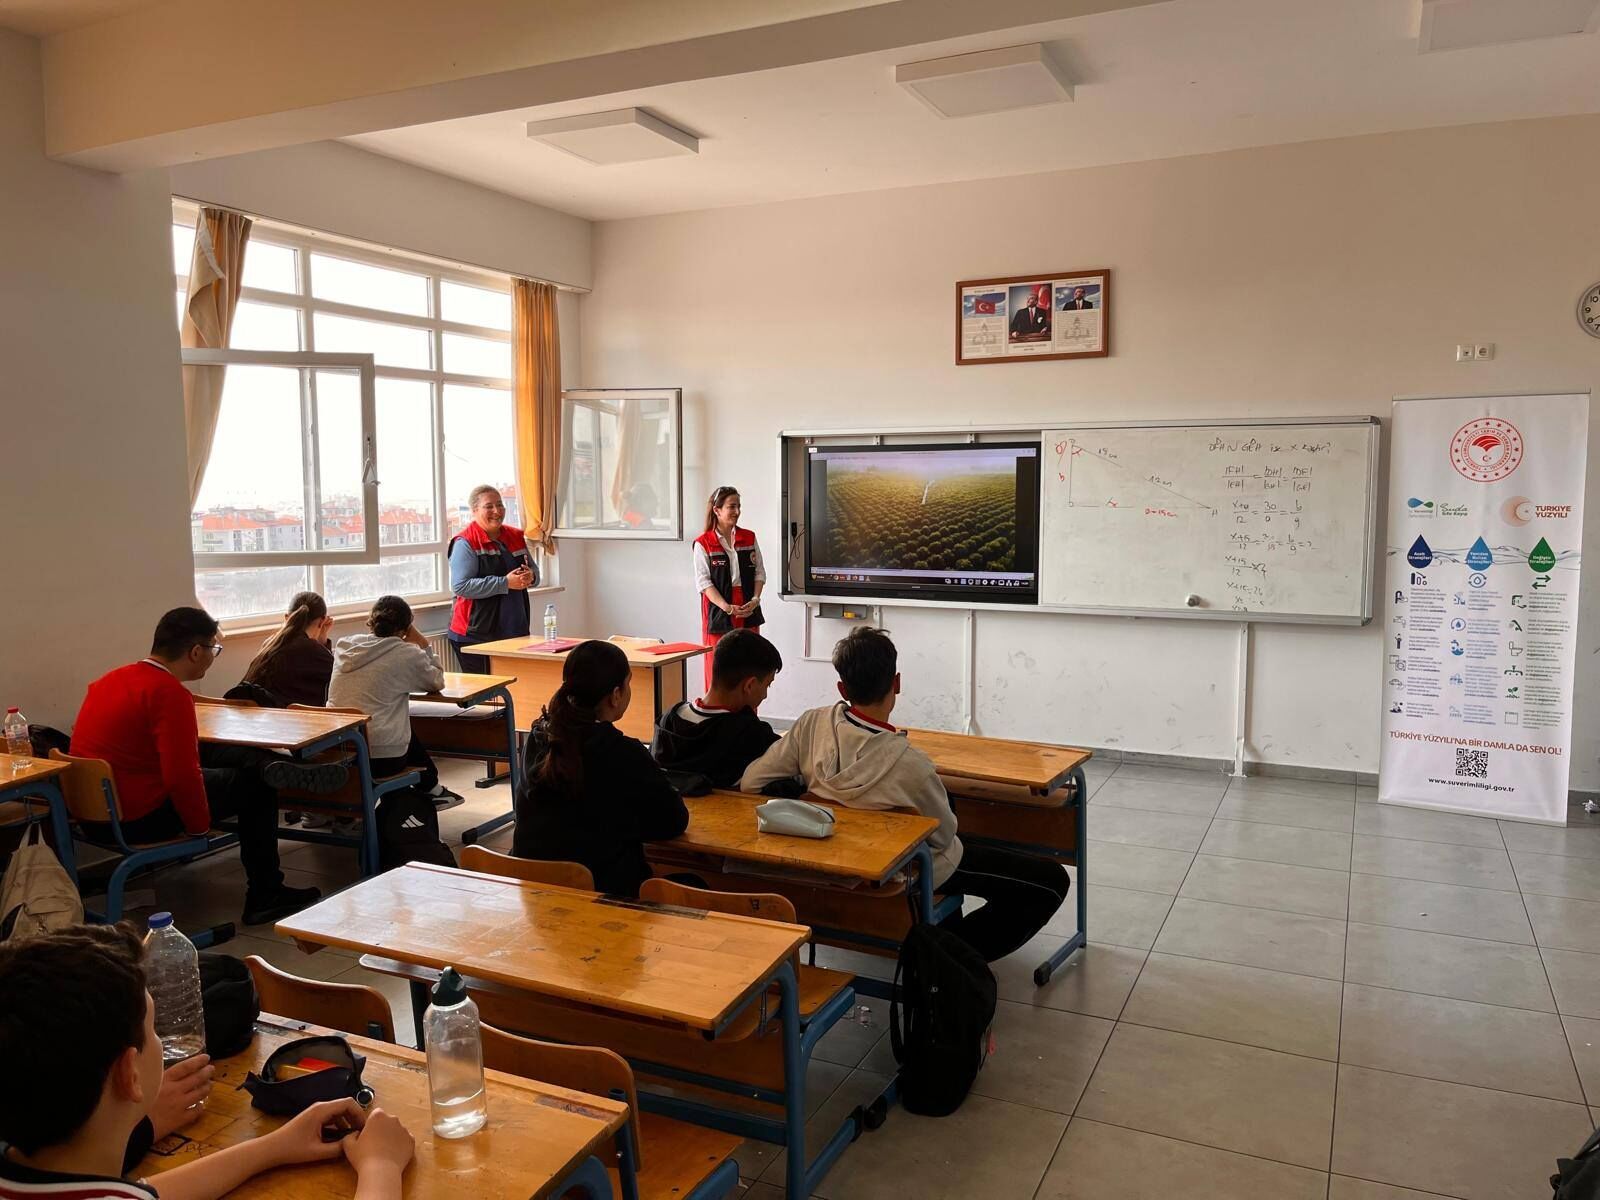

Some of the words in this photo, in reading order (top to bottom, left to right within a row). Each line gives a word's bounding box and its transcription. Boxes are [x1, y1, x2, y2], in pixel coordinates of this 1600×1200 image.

[1390, 730, 1422, 740] TÜRKİYE
[1468, 738, 1482, 747] BİR
[1484, 740, 1514, 751] DAMLA
[1516, 744, 1528, 752] DA
[1529, 745, 1546, 754] SEN
[1548, 746, 1562, 756] OL!
[1428, 778, 1514, 792] www.suverimliligi.gov.tr
